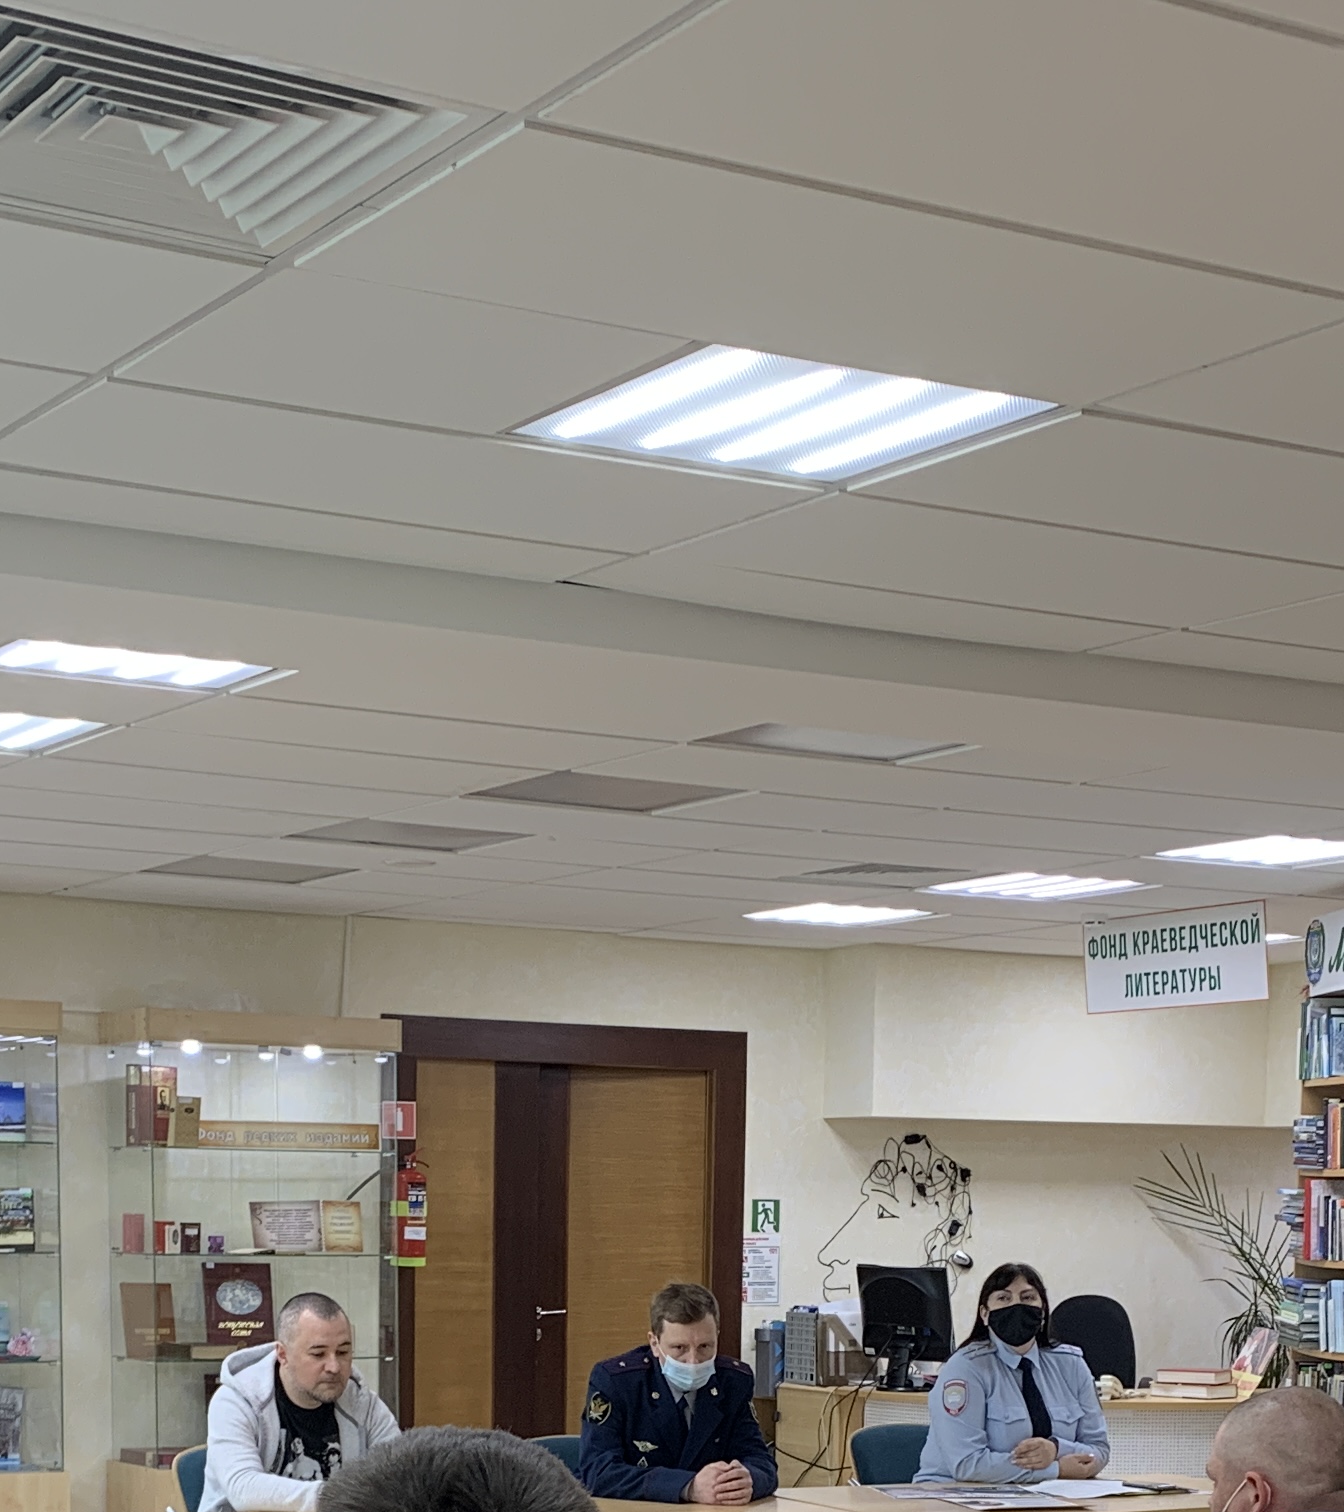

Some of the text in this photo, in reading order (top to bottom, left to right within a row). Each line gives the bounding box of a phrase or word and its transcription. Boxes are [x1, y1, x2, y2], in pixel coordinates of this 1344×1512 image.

[1088, 912, 1261, 960] ФОНД КРАЕВЕДЧЕСКОЙ
[1124, 965, 1221, 998] ЛИТЕРАТУРЫ
[244, 1130, 297, 1143] редких
[306, 1130, 370, 1145] изданий
